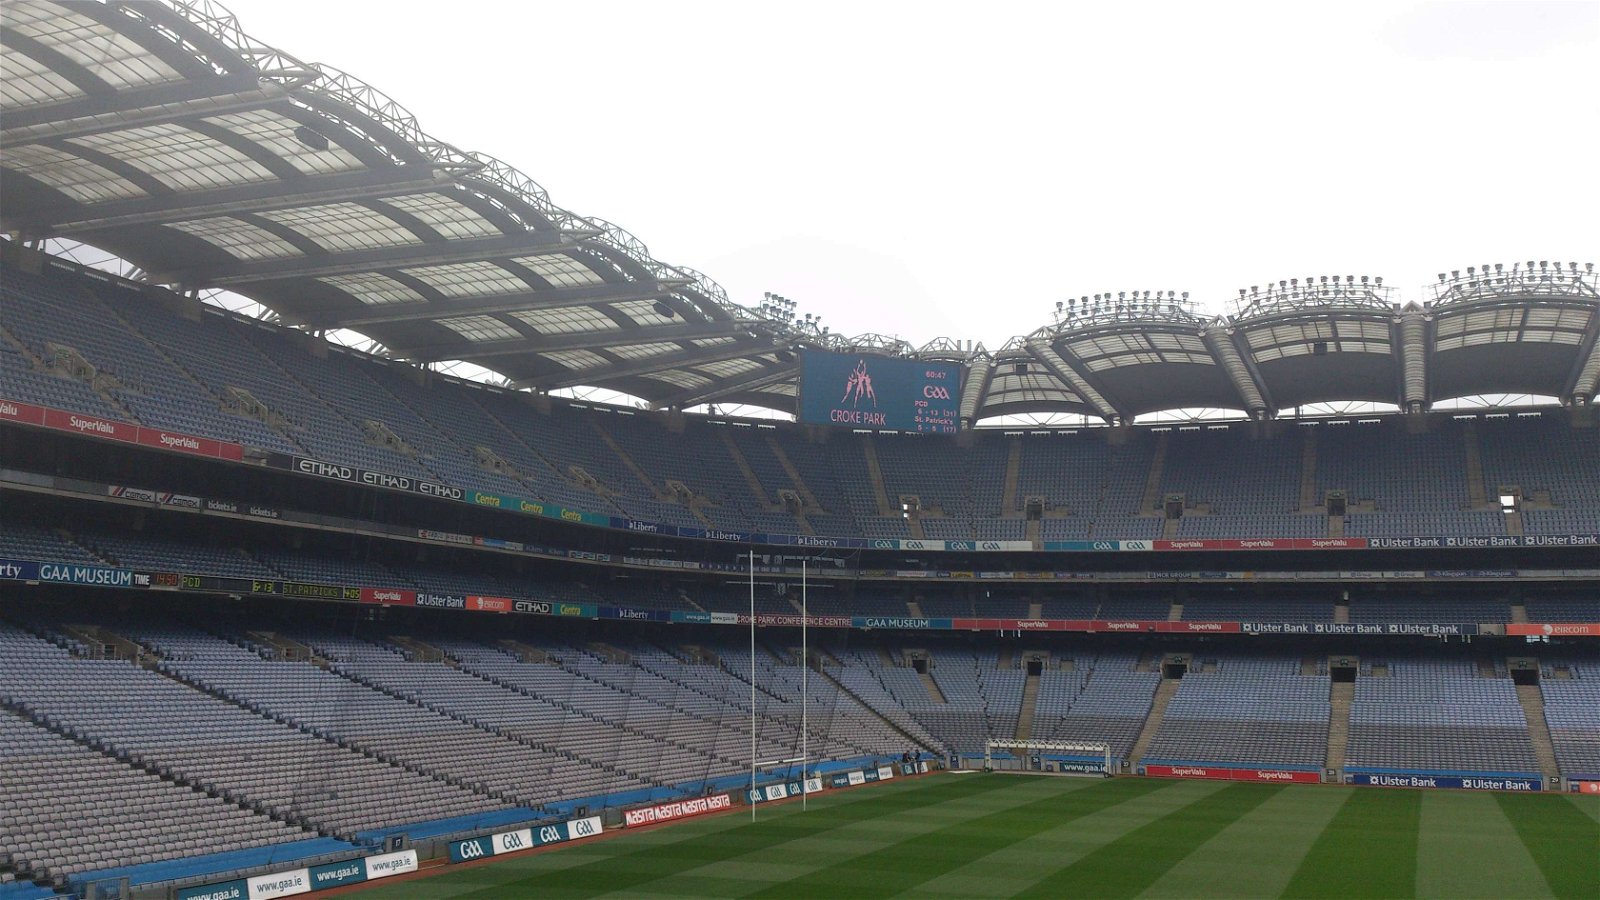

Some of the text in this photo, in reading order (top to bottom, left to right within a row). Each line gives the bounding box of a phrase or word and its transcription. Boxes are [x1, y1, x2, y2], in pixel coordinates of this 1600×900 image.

[926, 370, 946, 379] 60:47
[923, 385, 950, 400] GAA
[830, 409, 886, 426] CROKE PARK
[925, 416, 953, 425] Patrick's
[70, 416, 114, 434] SuperValu
[160, 433, 199, 450] SuperValu
[299, 460, 352, 480] ETIHAD
[363, 471, 410, 489] ETIHAD
[419, 482, 462, 499] ETIHAD
[475, 492, 500, 507] Centra
[208, 501, 237, 513] tickets.ie
[520, 500, 544, 515] Centra
[250, 507, 278, 519] tickets.ie
[561, 508, 582, 522] Centra
[633, 522, 658, 534] Liberty
[711, 531, 742, 543] Liberty
[804, 536, 838, 547] Liberty
[1381, 537, 1440, 547] Ulster Bank
[1457, 536, 1518, 547] Ulster Bank
[1536, 535, 1598, 546] Ulster Bank
[874, 540, 894, 549] GAA
[906, 540, 925, 549] GAA
[951, 541, 970, 550] GAA
[982, 541, 1002, 550] GAA
[1093, 540, 1113, 550] GAA
[1126, 540, 1146, 550] GAA
[1171, 541, 1204, 549] SuperValu
[1240, 540, 1274, 548] SuperValu
[1312, 540, 1347, 548] SuperValu
[41, 565, 132, 585] GAA MUSEUM
[134, 573, 150, 586] TIME
[182, 576, 201, 588] PCD
[374, 591, 401, 601] SuperValu
[425, 593, 464, 608] Ulster Bank
[515, 602, 549, 613] ETIHAD
[560, 605, 581, 616] Centra
[624, 610, 649, 620] Liberty
[758, 616, 776, 625] PARK
[777, 616, 823, 626] CONFERENCE
[825, 617, 852, 626] CENTRE
[866, 618, 929, 628] GAA MUSEUM
[1017, 621, 1049, 630] SuperValu
[1108, 622, 1139, 630] SuperValu
[1189, 622, 1222, 631] SuperValu
[1252, 623, 1308, 633] Ulster Bank
[1325, 624, 1382, 634] Ulster Bank
[1399, 624, 1459, 635] Ulster Bank
[1172, 767, 1206, 777] SuperValu
[1257, 770, 1293, 780] SuperValu
[1380, 775, 1436, 789] Ulster Bank
[1473, 778, 1531, 791] Ulster Bank
[576, 820, 595, 836] GAA
[540, 826, 561, 843] GAA
[503, 832, 523, 849] GAA
[460, 840, 484, 859] GAA
[372, 856, 411, 872] www.gaa.ie
[316, 865, 359, 882] www.gaa.ie
[257, 876, 302, 893] www.gaa.ie
[187, 886, 240, 900] w.gaa.ie
